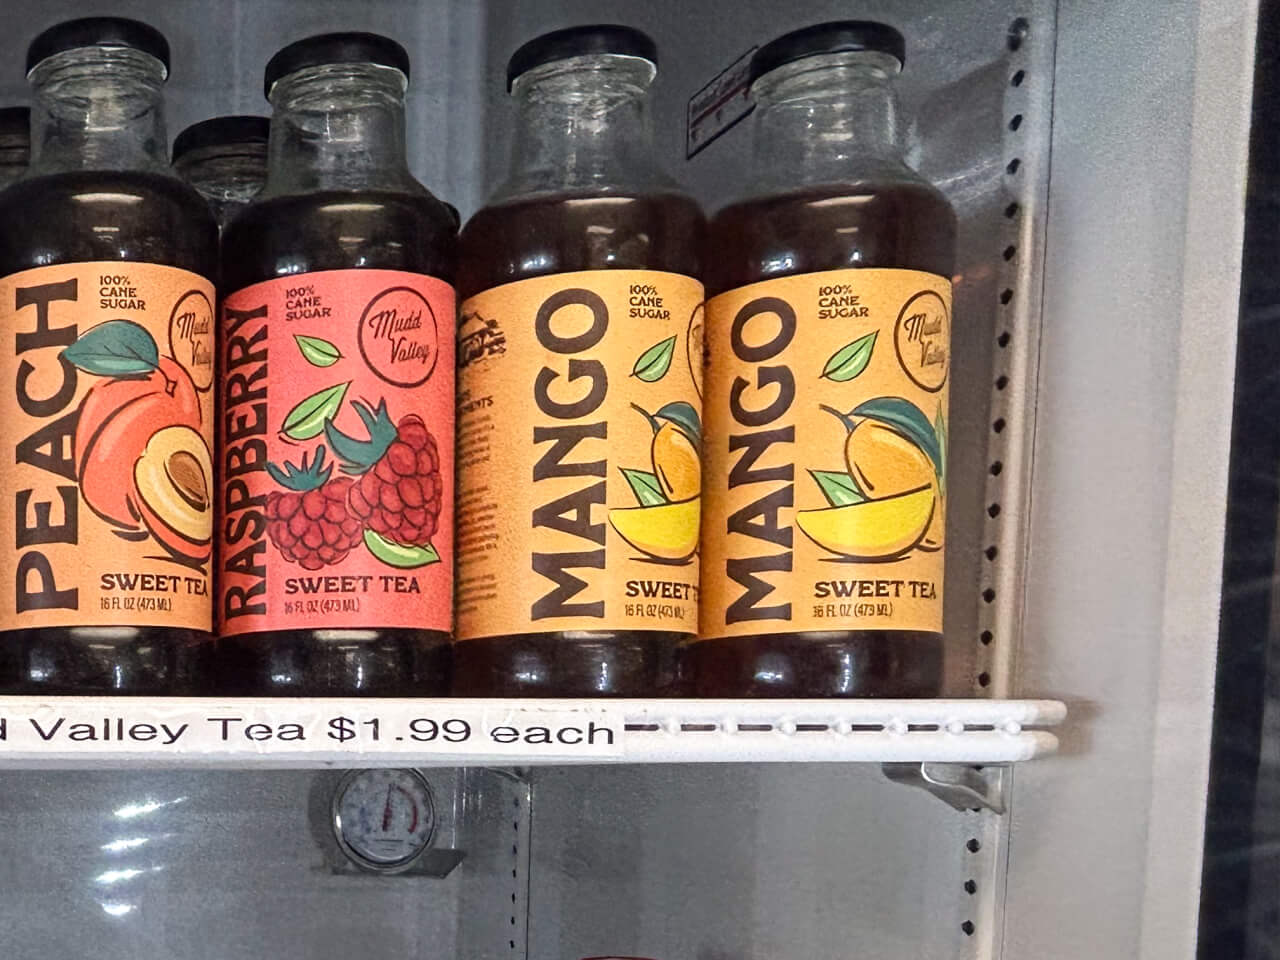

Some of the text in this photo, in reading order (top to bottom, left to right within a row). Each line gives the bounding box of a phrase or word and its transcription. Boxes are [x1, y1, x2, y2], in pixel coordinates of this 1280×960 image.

[99, 275, 131, 286] 100%
[99, 286, 137, 299] CANE
[285, 285, 316, 299] 100%
[629, 284, 658, 297] 100%
[818, 285, 853, 297] 100%
[99, 298, 146, 311] SUGAR
[285, 296, 322, 310] CANE
[629, 296, 664, 309] CANE
[818, 295, 860, 308] CANE
[285, 307, 332, 322] SUGAR
[629, 308, 671, 321] SUGAR
[818, 306, 869, 319] SUGAR
[368, 309, 423, 340] Mudd
[388, 336, 431, 366] Valley
[15, 277, 79, 614] PEACH
[224, 303, 270, 620] RASPBERRY
[530, 287, 609, 622] MANGO
[725, 296, 797, 625] MANGO
[100, 573, 209, 597] SWEET TEA
[285, 575, 421, 594] SWEET TEA
[625, 580, 691, 600] SWEET
[814, 580, 937, 600] SWEET TEA
[29, 716, 188, 746] Valley
[207, 716, 307, 743] Tea
[327, 716, 472, 744] $1.99
[490, 717, 616, 745] each
